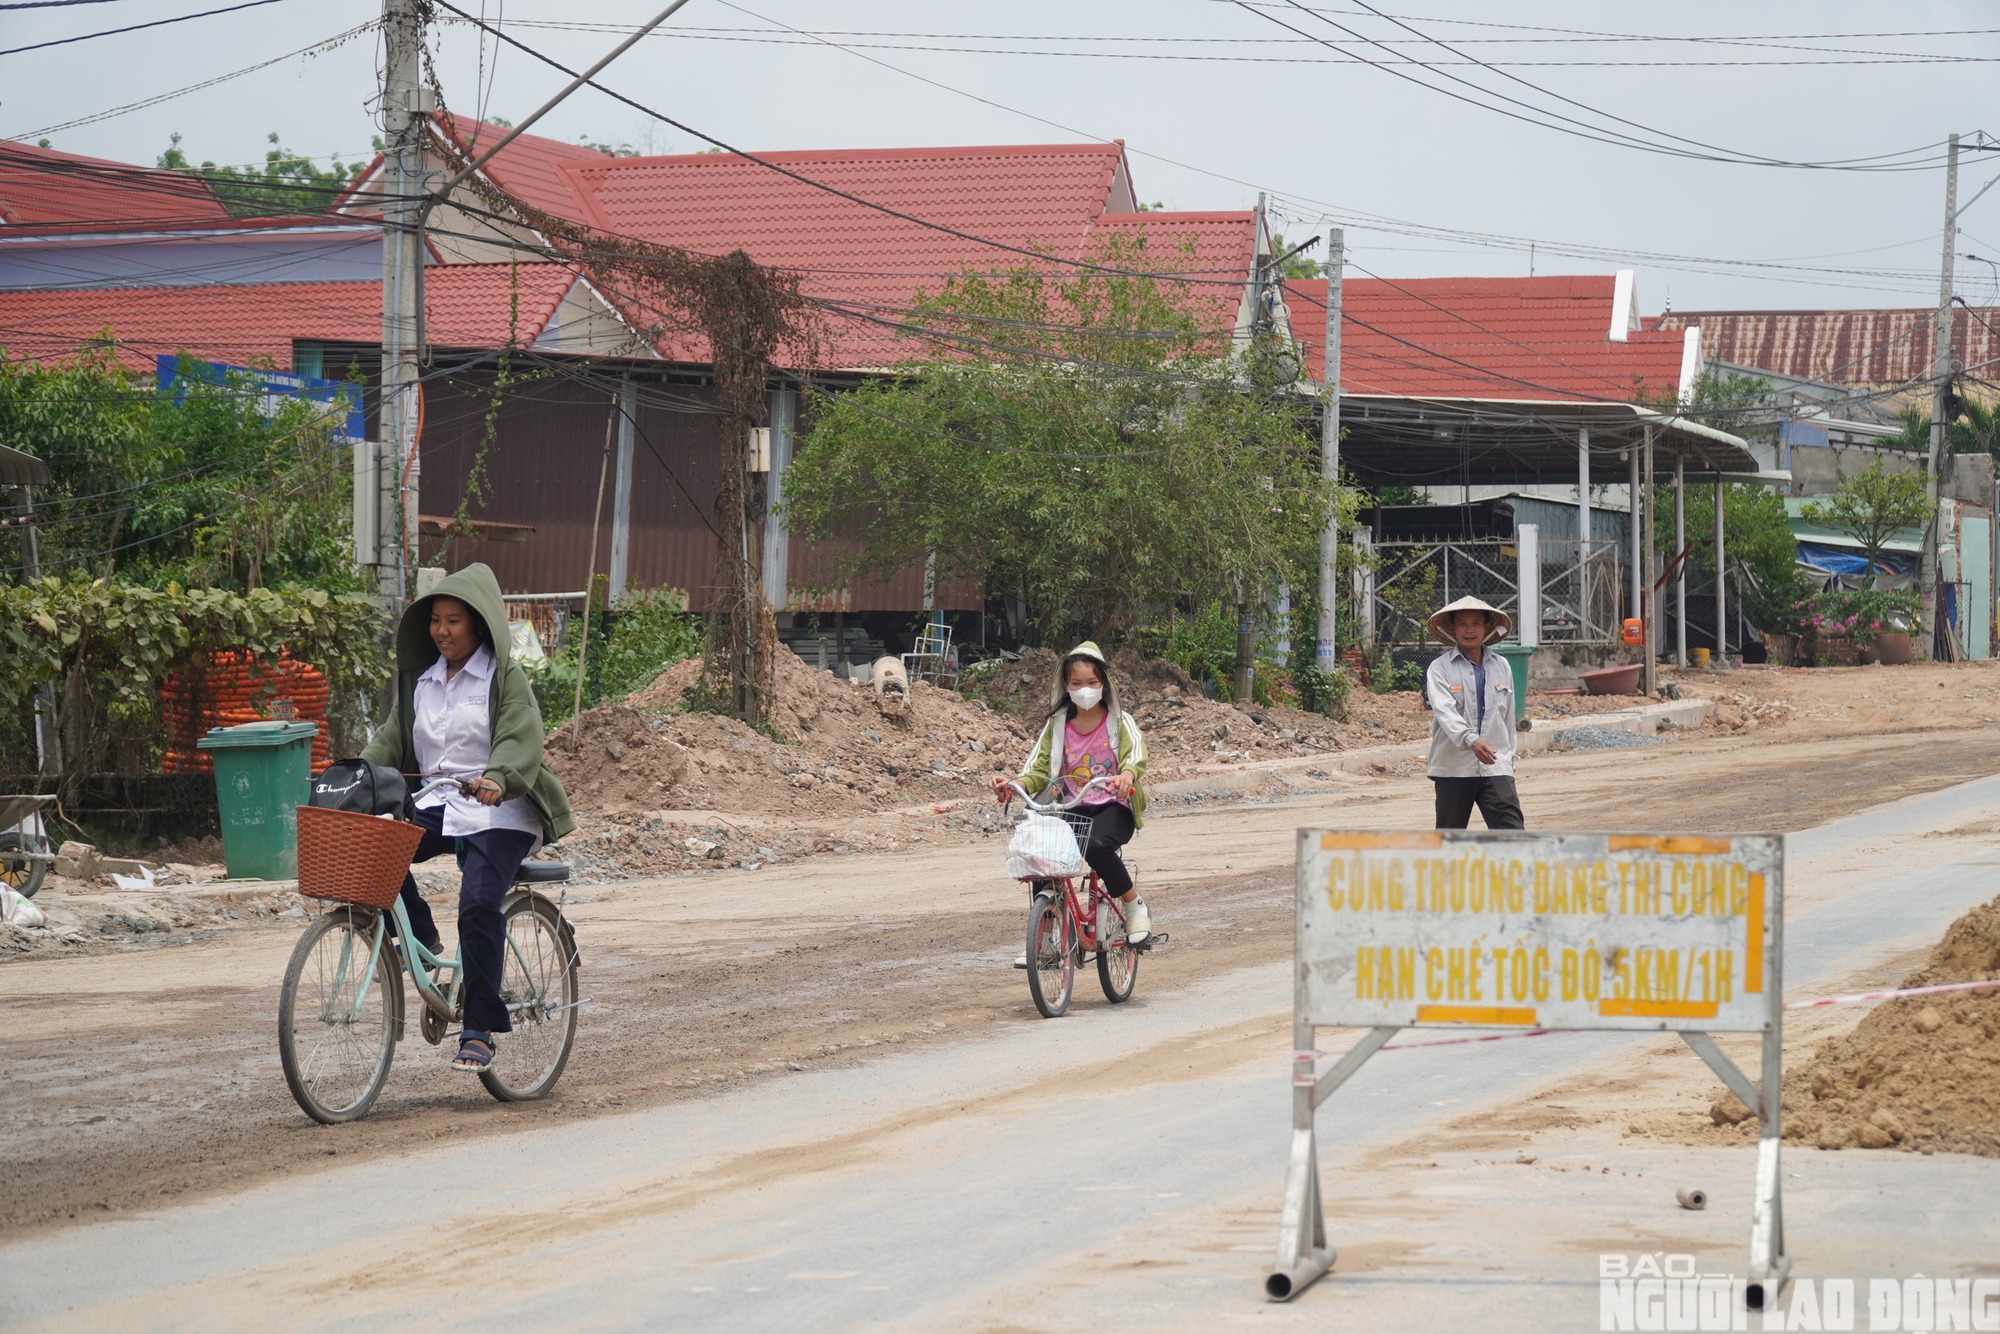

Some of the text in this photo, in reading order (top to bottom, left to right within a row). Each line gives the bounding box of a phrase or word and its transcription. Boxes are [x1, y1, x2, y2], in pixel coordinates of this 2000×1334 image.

[1412, 844, 1524, 914] TRƯỜNG
[1616, 861, 1661, 915] THI
[1356, 933, 1733, 1012] HẠN CHẾ TỐC ĐỘ 5KM/1H
